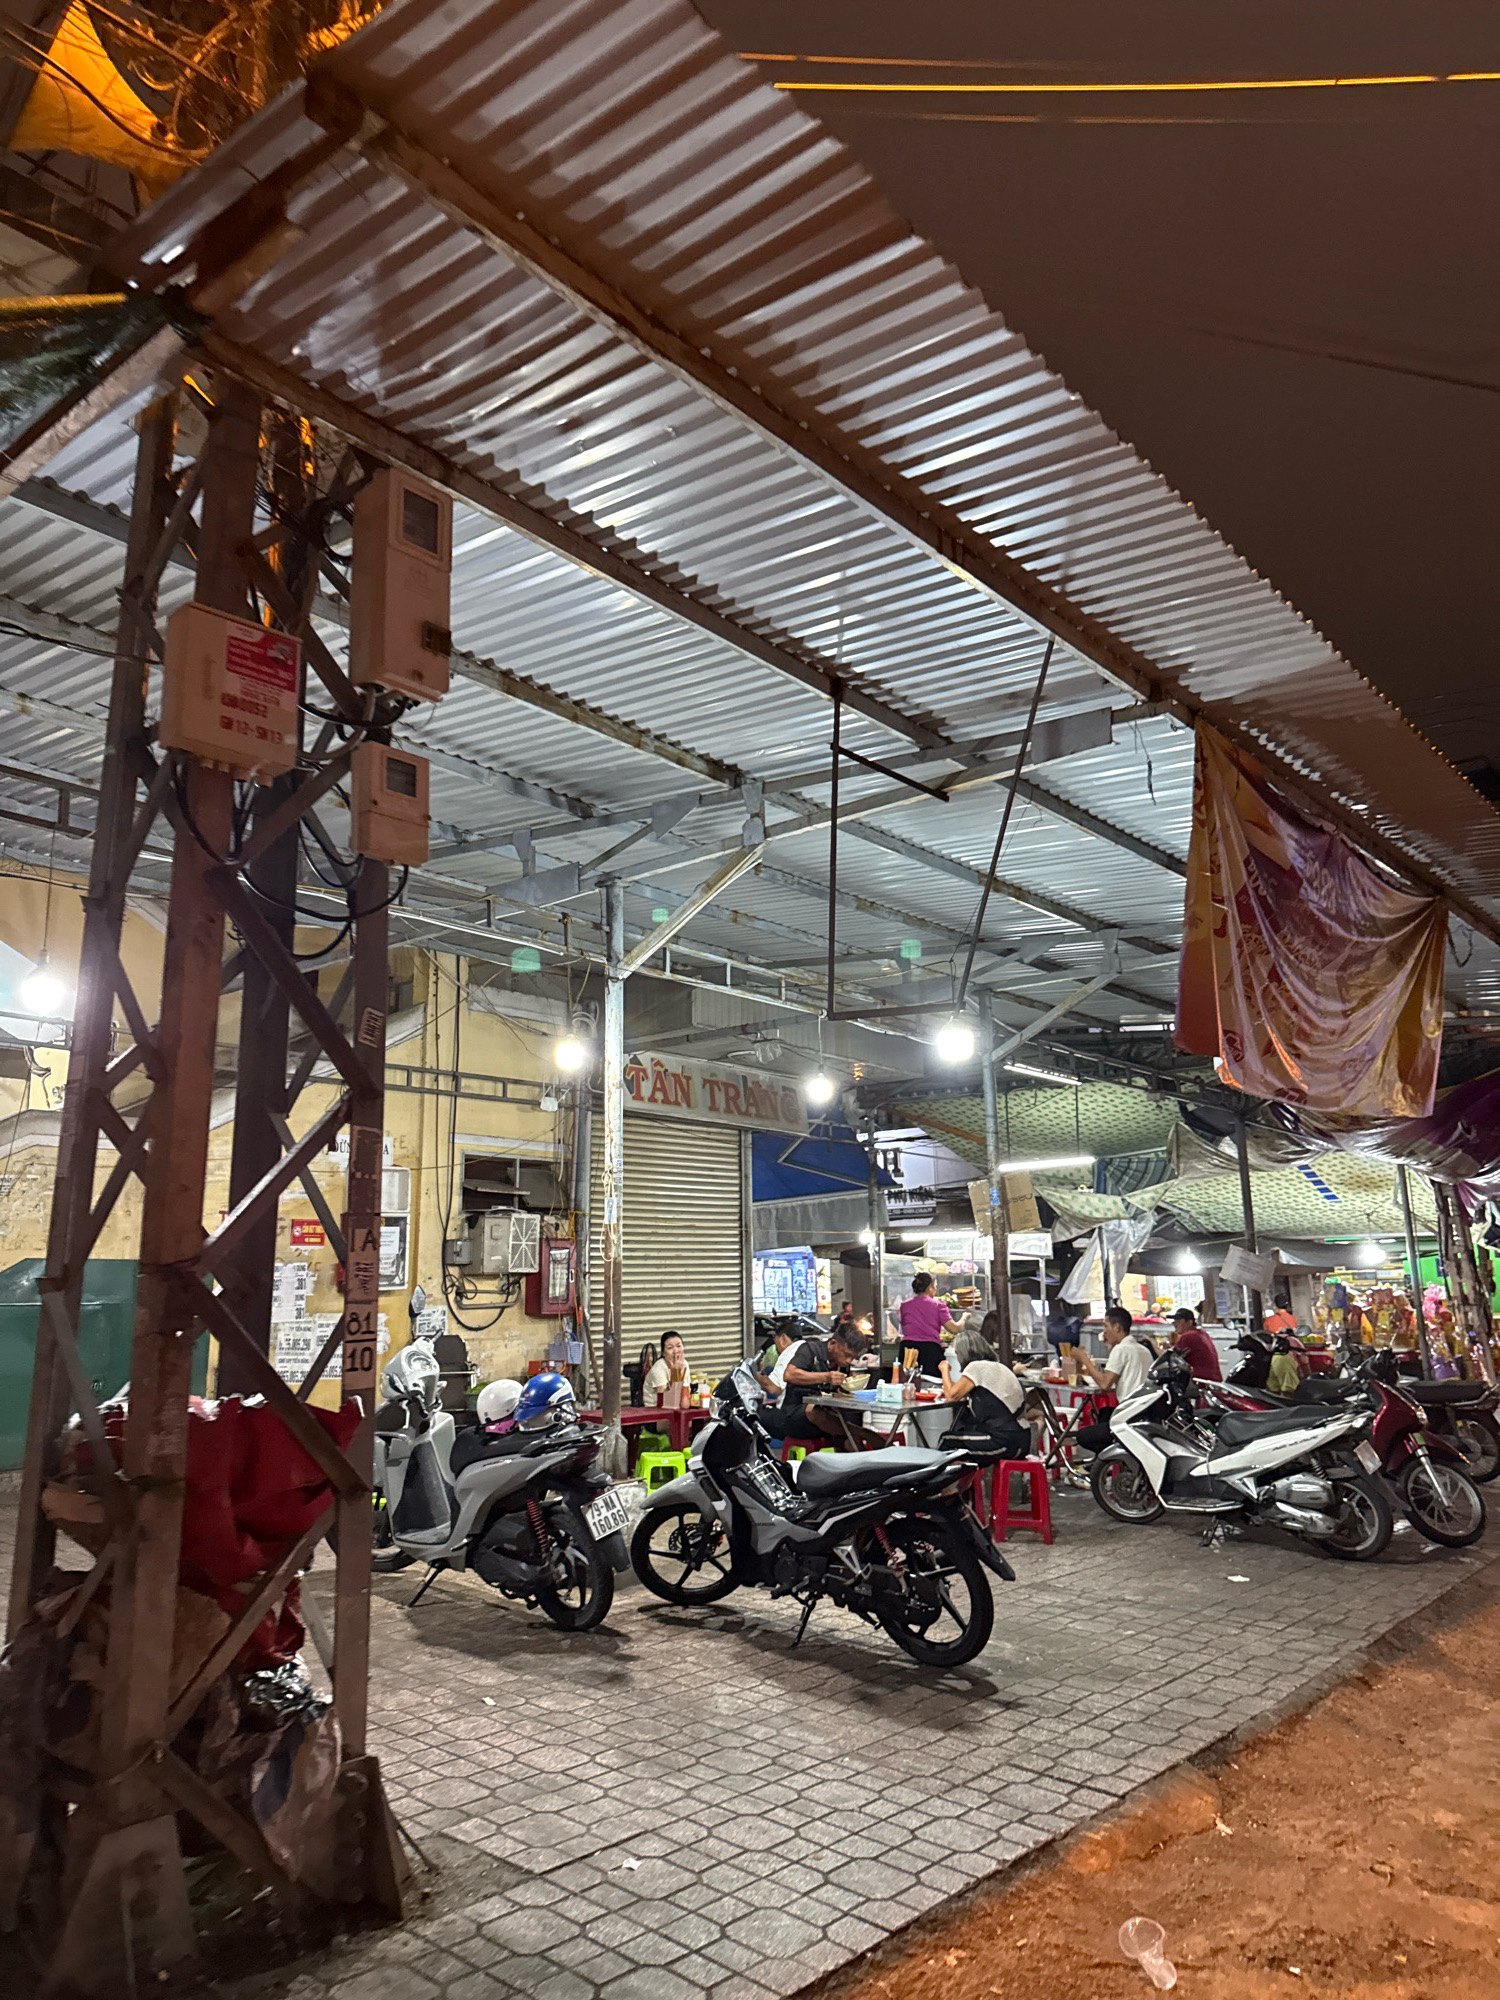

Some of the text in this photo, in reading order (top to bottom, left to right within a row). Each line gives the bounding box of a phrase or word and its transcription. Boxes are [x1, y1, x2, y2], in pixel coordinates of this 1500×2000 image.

[626, 1058, 693, 1108] TÂN
[346, 1312, 376, 1337] 81
[345, 1346, 374, 1373] 10
[592, 1509, 626, 1536] 160.86
